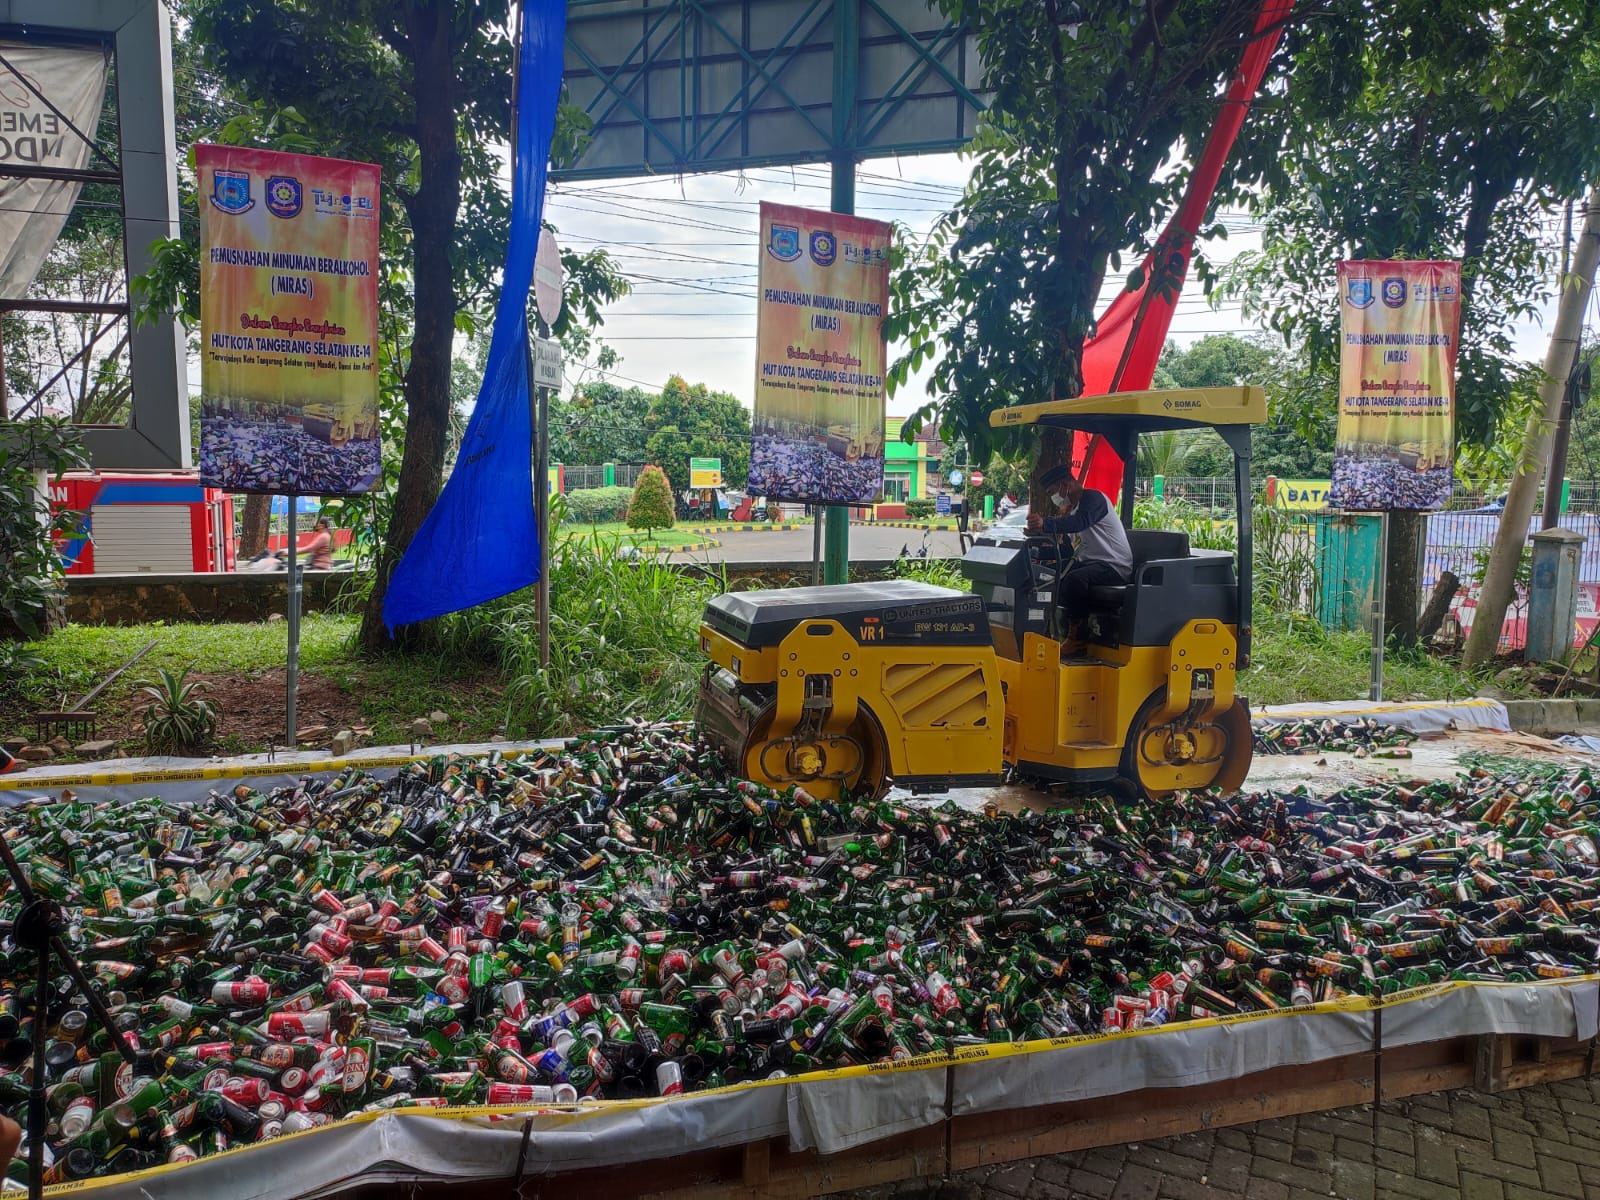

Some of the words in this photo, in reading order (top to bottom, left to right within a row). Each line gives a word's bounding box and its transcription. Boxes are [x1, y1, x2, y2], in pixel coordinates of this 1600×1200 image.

[210, 247, 270, 267] PEMUSNAHAN
[271, 252, 316, 271] MINUMAN
[318, 257, 370, 276] BERALKOHOL
[764, 288, 811, 307] PEMUSNAHAN
[812, 294, 844, 311] MINUMAN
[211, 333, 229, 348] HUT
[230, 336, 253, 350] KOTA
[256, 338, 311, 354] TANGERANG
[314, 342, 348, 358] SELATAN
[349, 345, 371, 359] KE-14
[1385, 333, 1414, 345] MINUMAN
[763, 363, 777, 376] HUT
[778, 365, 796, 378] KOTA
[797, 367, 837, 382] TANGERANG
[838, 372, 864, 385] SELATAN
[1174, 400, 1201, 409] BOMAG
[1371, 397, 1408, 406] TANGERANG
[1408, 397, 1433, 406] SELATAN
[901, 607, 931, 619] UNITED
[935, 601, 981, 614] TRACTORS
[860, 625, 875, 640] VR
[879, 625, 884, 640] 1
